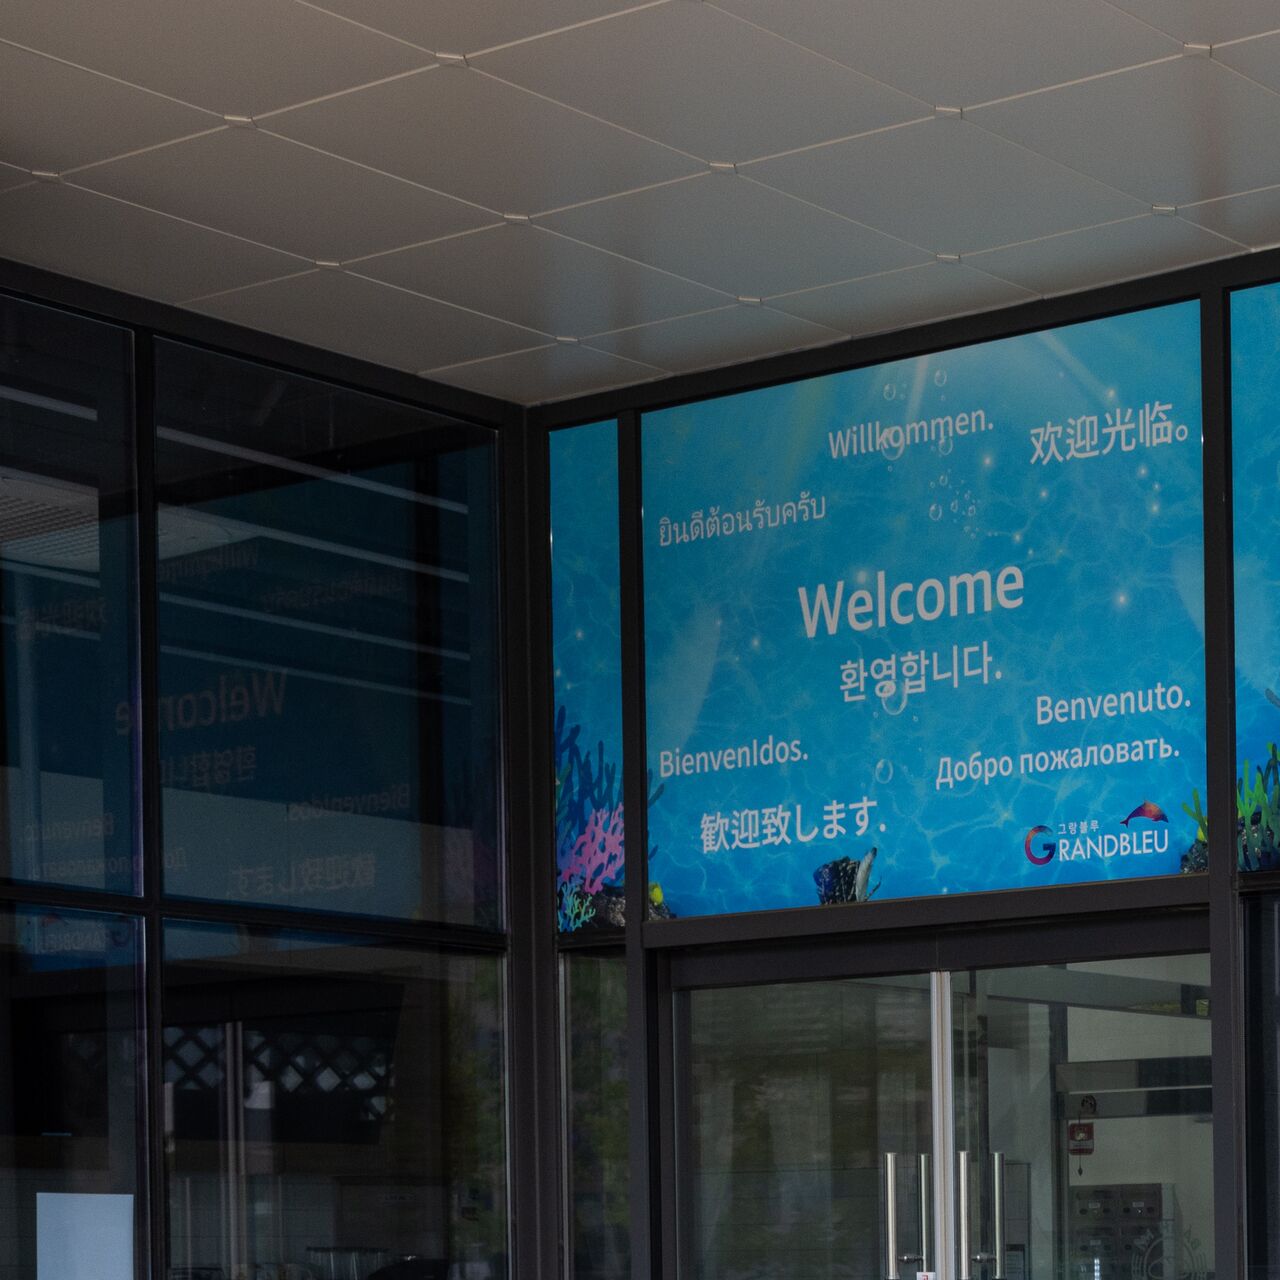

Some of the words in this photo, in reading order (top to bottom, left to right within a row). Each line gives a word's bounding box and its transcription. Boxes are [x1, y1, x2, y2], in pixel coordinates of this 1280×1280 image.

[828, 408, 995, 459] Willkommen.
[1030, 400, 1188, 465] 欢迎光临。
[659, 491, 826, 547] ยินดีต้อนรับครับ
[798, 566, 1024, 637] Welcome
[840, 641, 1003, 704] 환영합니다.
[1036, 683, 1192, 725] Benvenuto.
[936, 751, 1013, 790] Добро
[1019, 737, 1181, 775] пожаловать.
[1025, 825, 1169, 865] GRANDBLEU
[1058, 820, 1099, 835] 그랑블루
